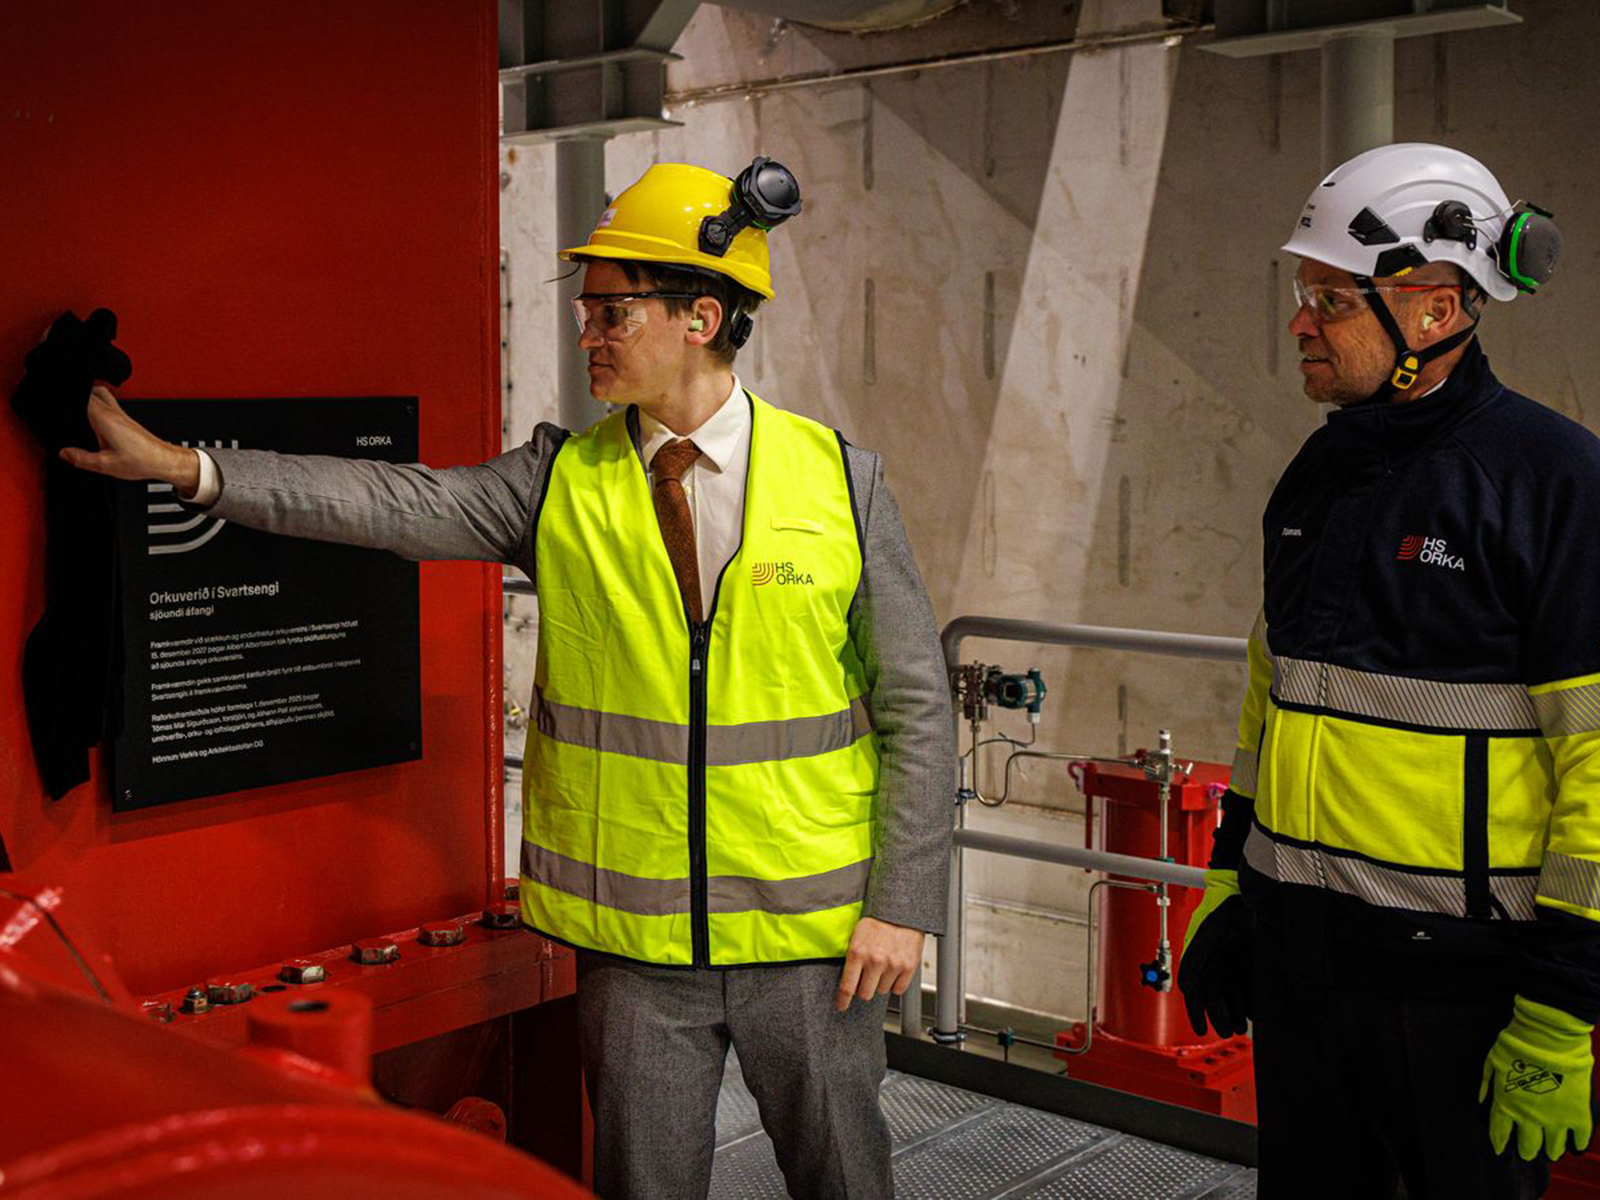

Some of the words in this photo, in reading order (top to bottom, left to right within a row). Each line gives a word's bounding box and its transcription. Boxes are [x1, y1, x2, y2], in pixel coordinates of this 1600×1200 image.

[356, 436, 368, 446] HS
[369, 436, 392, 446] ORKA
[1423, 537, 1447, 552] HS
[775, 562, 794, 573] HS
[1419, 549, 1465, 571] ORKA
[776, 573, 814, 585] ORKA
[149, 587, 210, 604] Orkuverið
[217, 581, 279, 598] Svartsengi
[149, 607, 184, 621] sjöundi
[185, 605, 214, 616] áfangi
